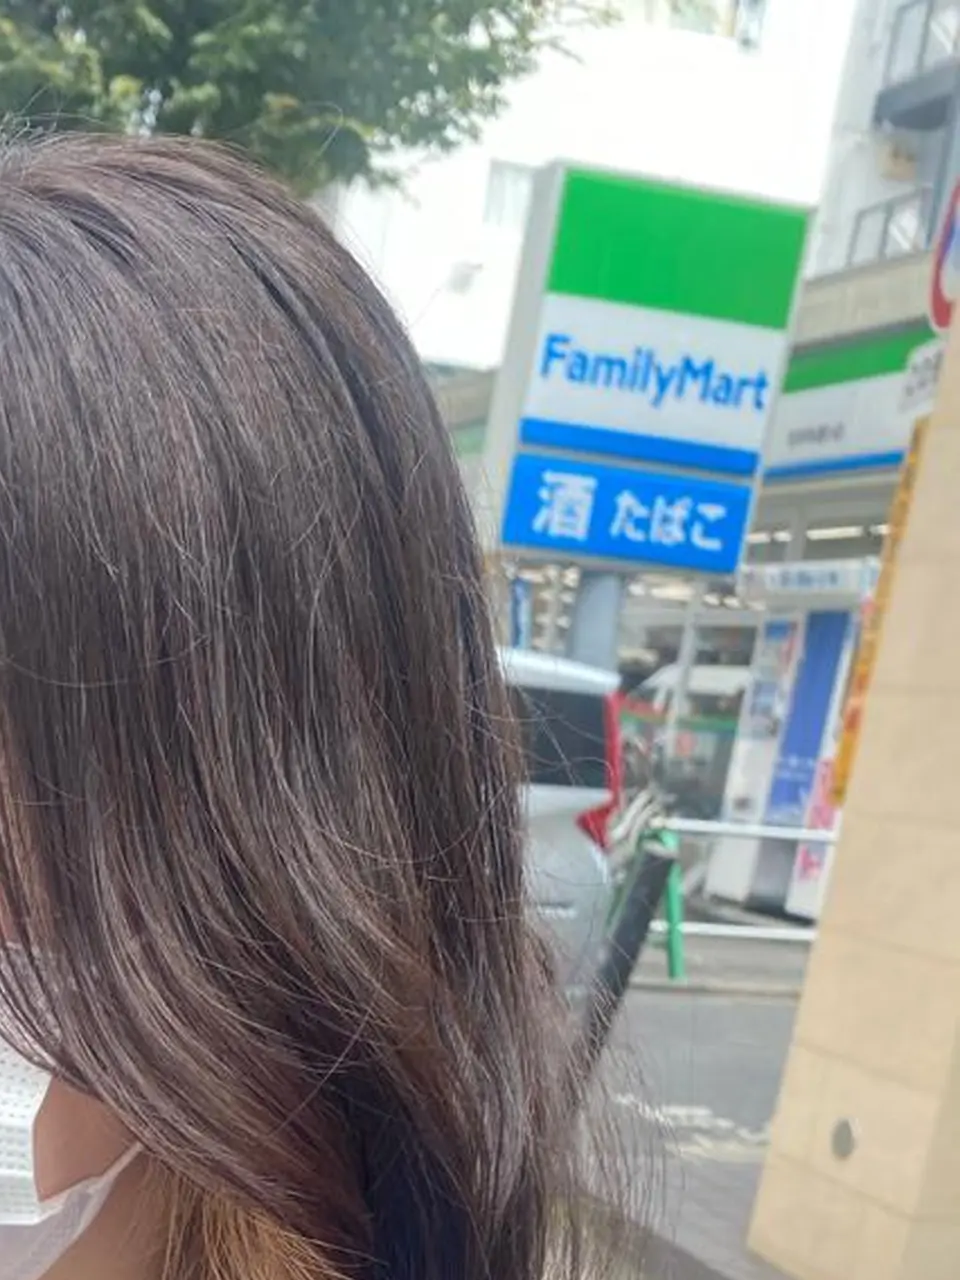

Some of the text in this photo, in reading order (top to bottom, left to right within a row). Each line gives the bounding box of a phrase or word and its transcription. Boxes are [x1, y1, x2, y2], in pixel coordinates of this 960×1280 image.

[541, 333, 768, 409] FamilyMart
[533, 470, 726, 550] 酒 たばこ
